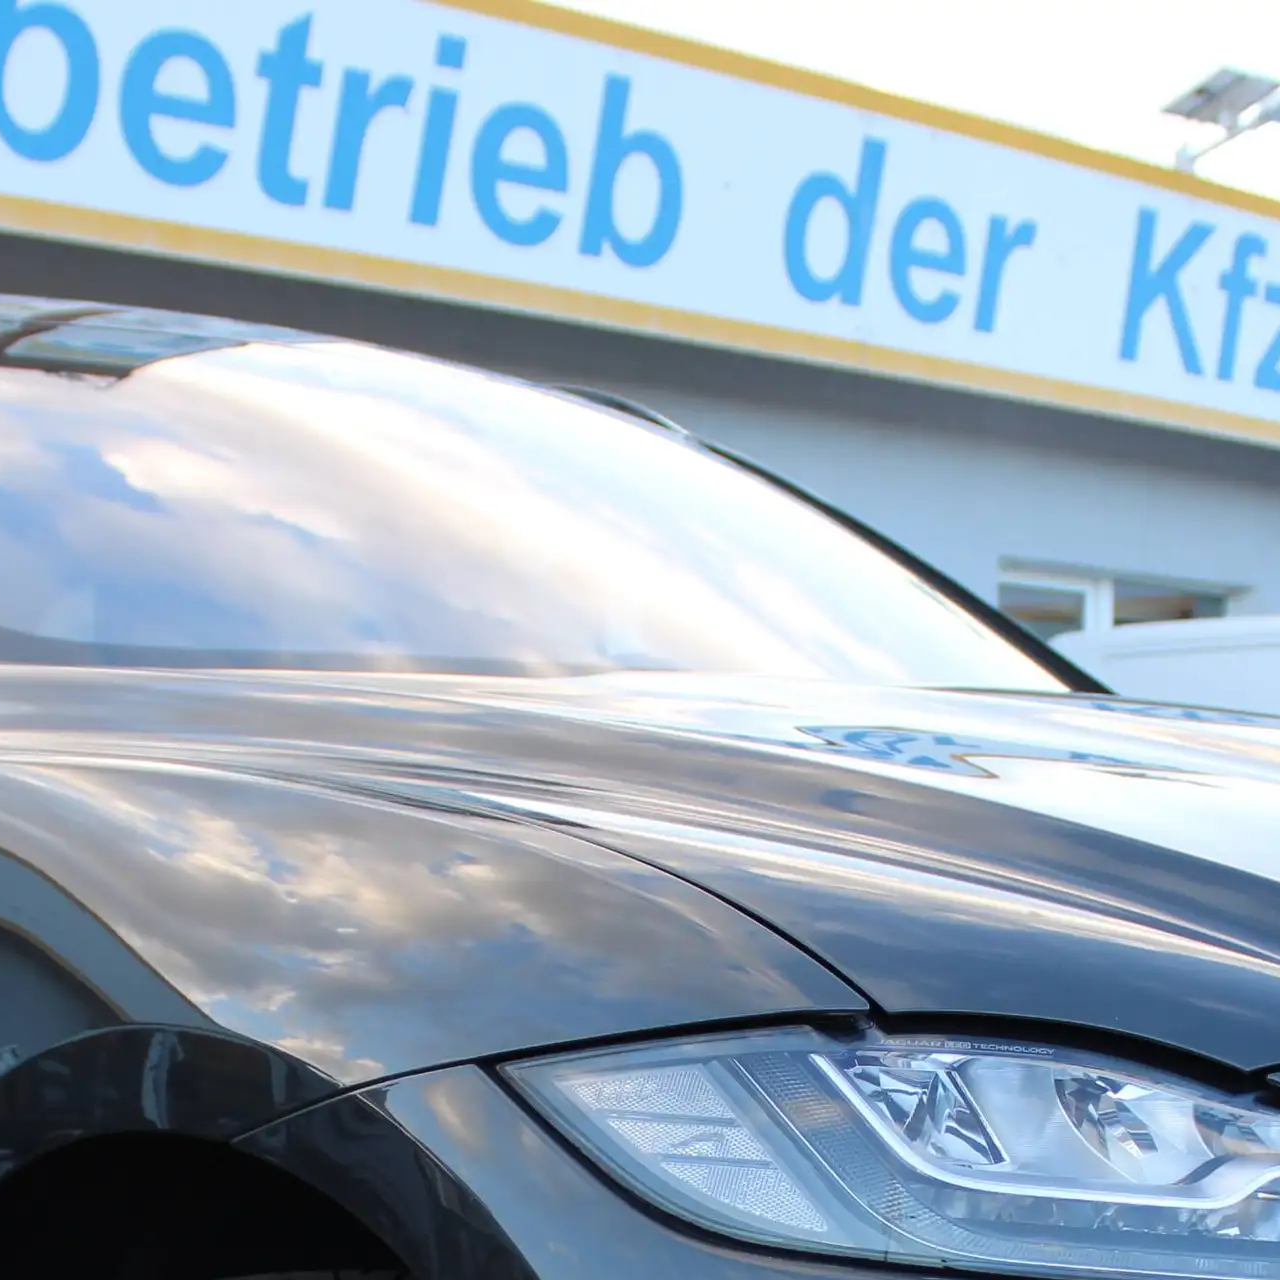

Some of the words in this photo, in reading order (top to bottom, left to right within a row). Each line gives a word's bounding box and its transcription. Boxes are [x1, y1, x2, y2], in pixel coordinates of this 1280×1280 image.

[783, 137, 1037, 332] der
[879, 1038, 942, 1048] JAGUAR
[972, 1042, 1056, 1055] TECHNOLOGY
